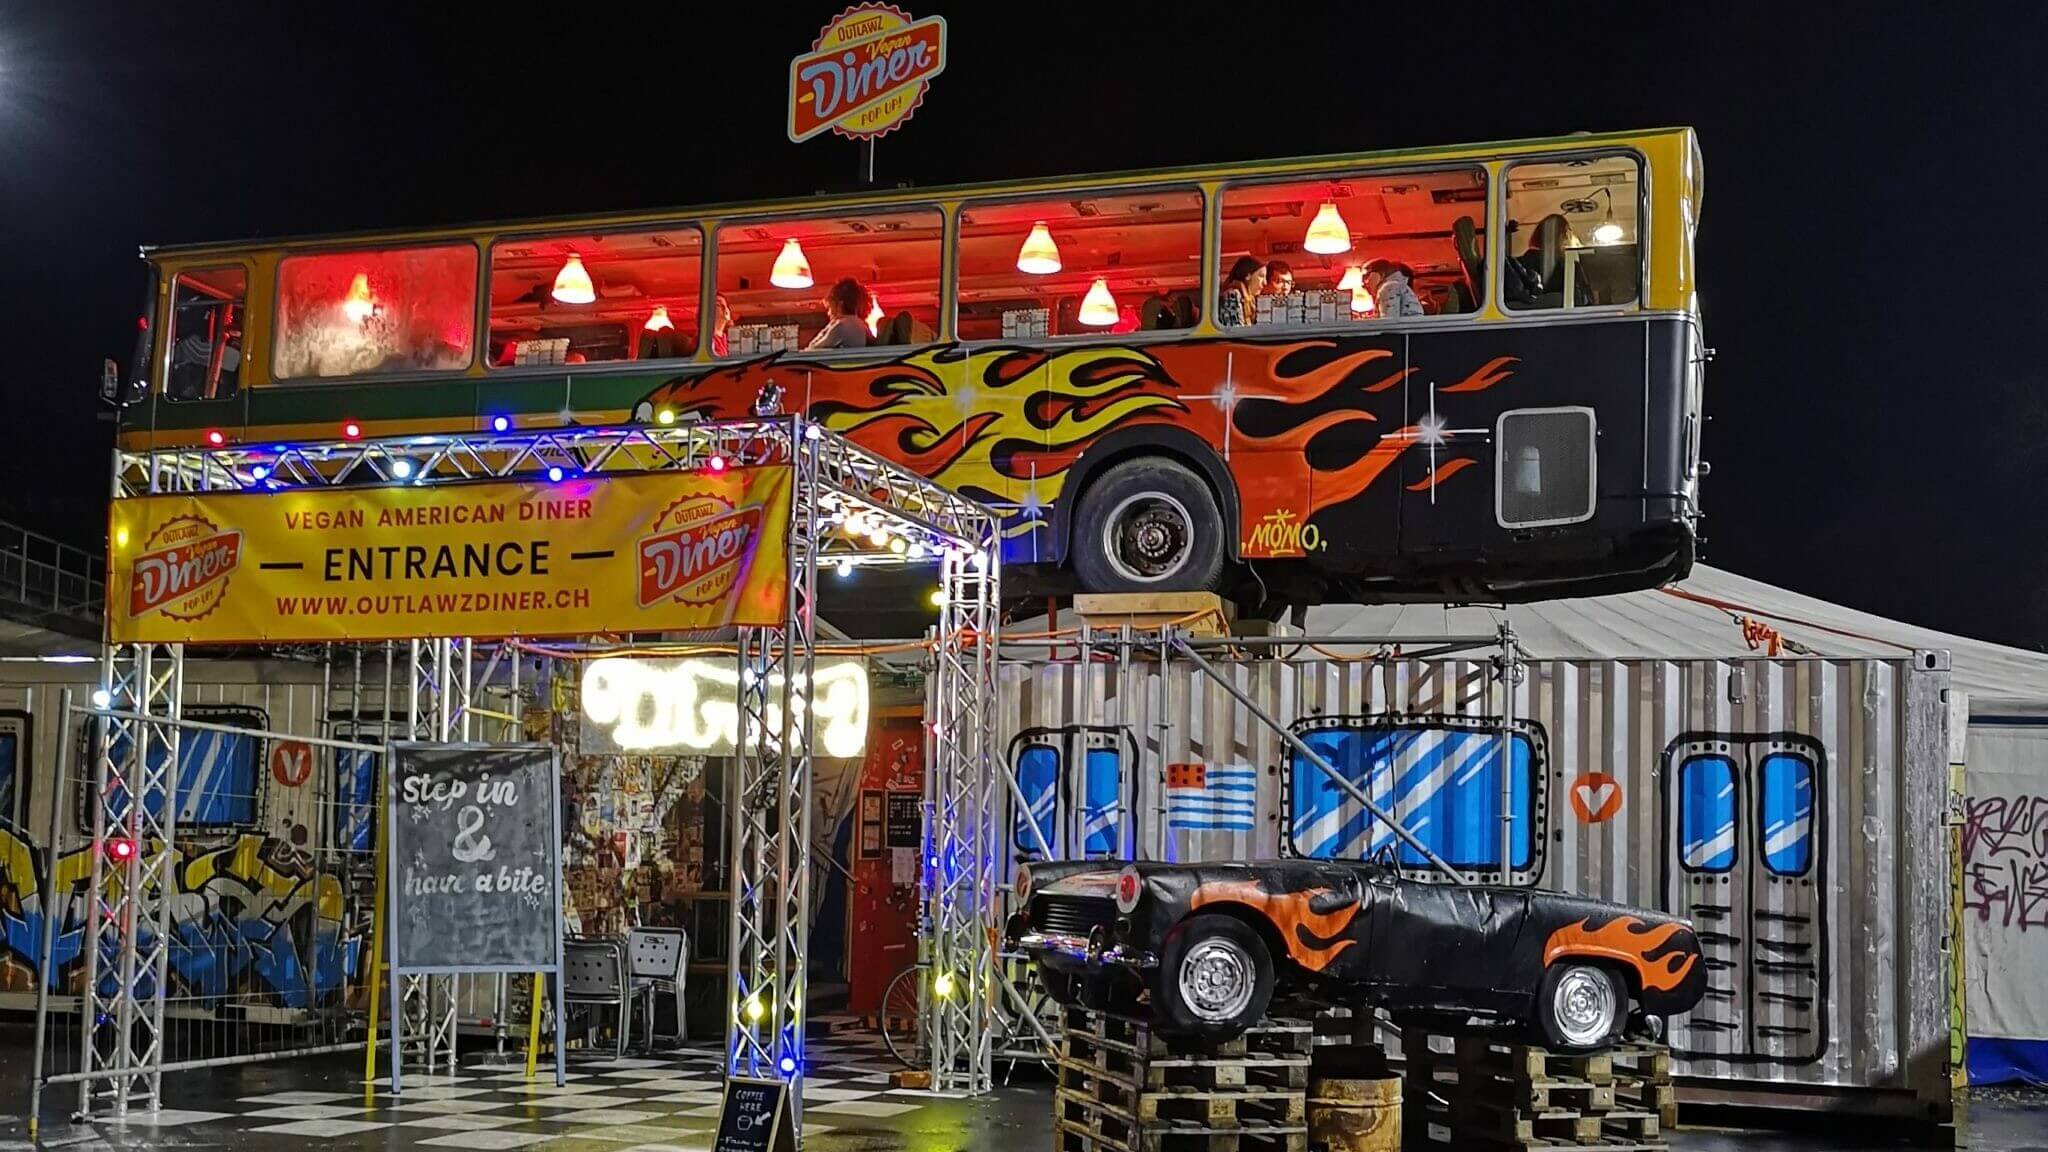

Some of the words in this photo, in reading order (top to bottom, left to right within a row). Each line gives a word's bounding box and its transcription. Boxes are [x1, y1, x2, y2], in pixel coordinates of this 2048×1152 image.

[838, 15, 883, 42] OUTLAWZ
[866, 35, 912, 60] Vegan
[801, 40, 931, 118] Diner
[861, 107, 881, 126] POP
[885, 96, 903, 115] UP!
[285, 510, 364, 530] VEGAN
[377, 503, 505, 527] AMERICAN
[519, 499, 592, 521] DINER
[136, 545, 230, 603] Diner
[324, 541, 550, 582] ENTRANCE
[644, 524, 750, 589] Diner
[276, 588, 590, 616] WWW.OUTLAWZDINER.CH
[403, 773, 467, 811] Step
[476, 772, 519, 806] in
[452, 805, 497, 863] &
[405, 866, 466, 897] have
[475, 873, 493, 893] a
[497, 866, 545, 893] bite
